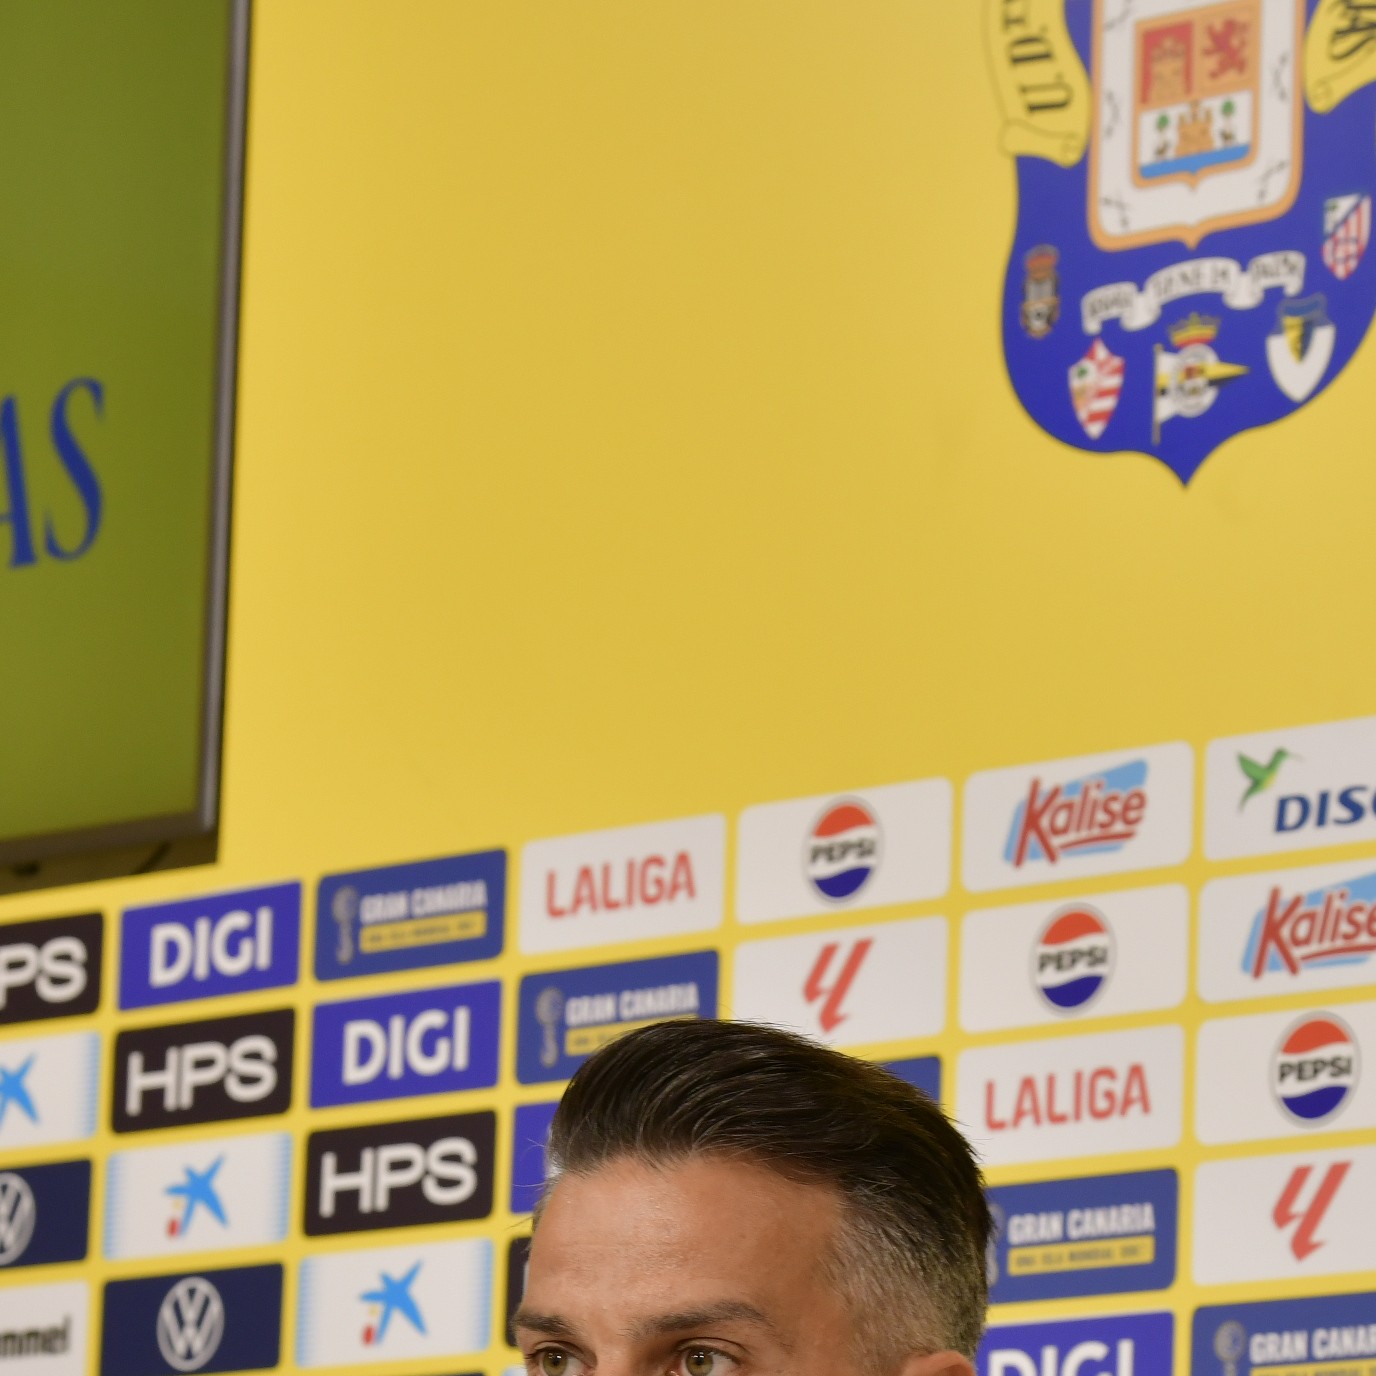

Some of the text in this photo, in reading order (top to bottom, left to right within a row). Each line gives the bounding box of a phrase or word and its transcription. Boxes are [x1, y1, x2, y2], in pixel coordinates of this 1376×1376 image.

[810, 839, 875, 867] PEPSI
[1013, 777, 1147, 868] Kalise
[546, 852, 695, 918] LALIGA
[150, 907, 271, 986] DIGI
[1038, 946, 1107, 971] PEPSI
[126, 1035, 275, 1113] HPS
[343, 1007, 469, 1084] DIGI
[1278, 1056, 1351, 1081] PEPSI
[985, 1064, 1150, 1130] LALIGA
[320, 1137, 475, 1215] HPS
[1008, 1203, 1154, 1244] GRAN CANARIA
[1249, 1331, 1307, 1363] GRAN
